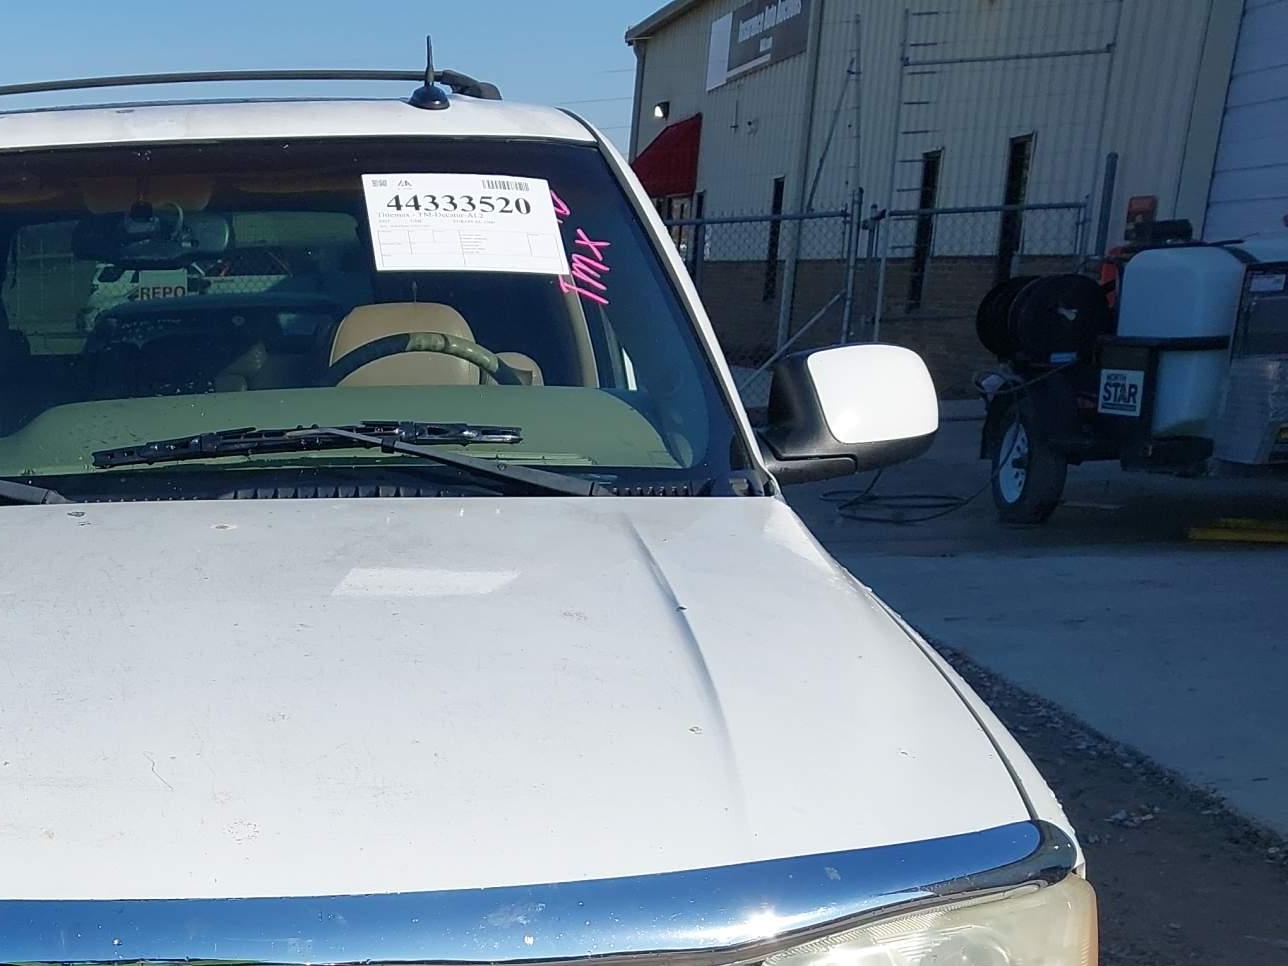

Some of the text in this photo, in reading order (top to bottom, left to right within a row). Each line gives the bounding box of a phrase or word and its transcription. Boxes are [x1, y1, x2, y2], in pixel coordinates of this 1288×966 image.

[386, 193, 531, 215] 44333520
[140, 286, 186, 300] REPO
[1103, 382, 1138, 404] STAR
